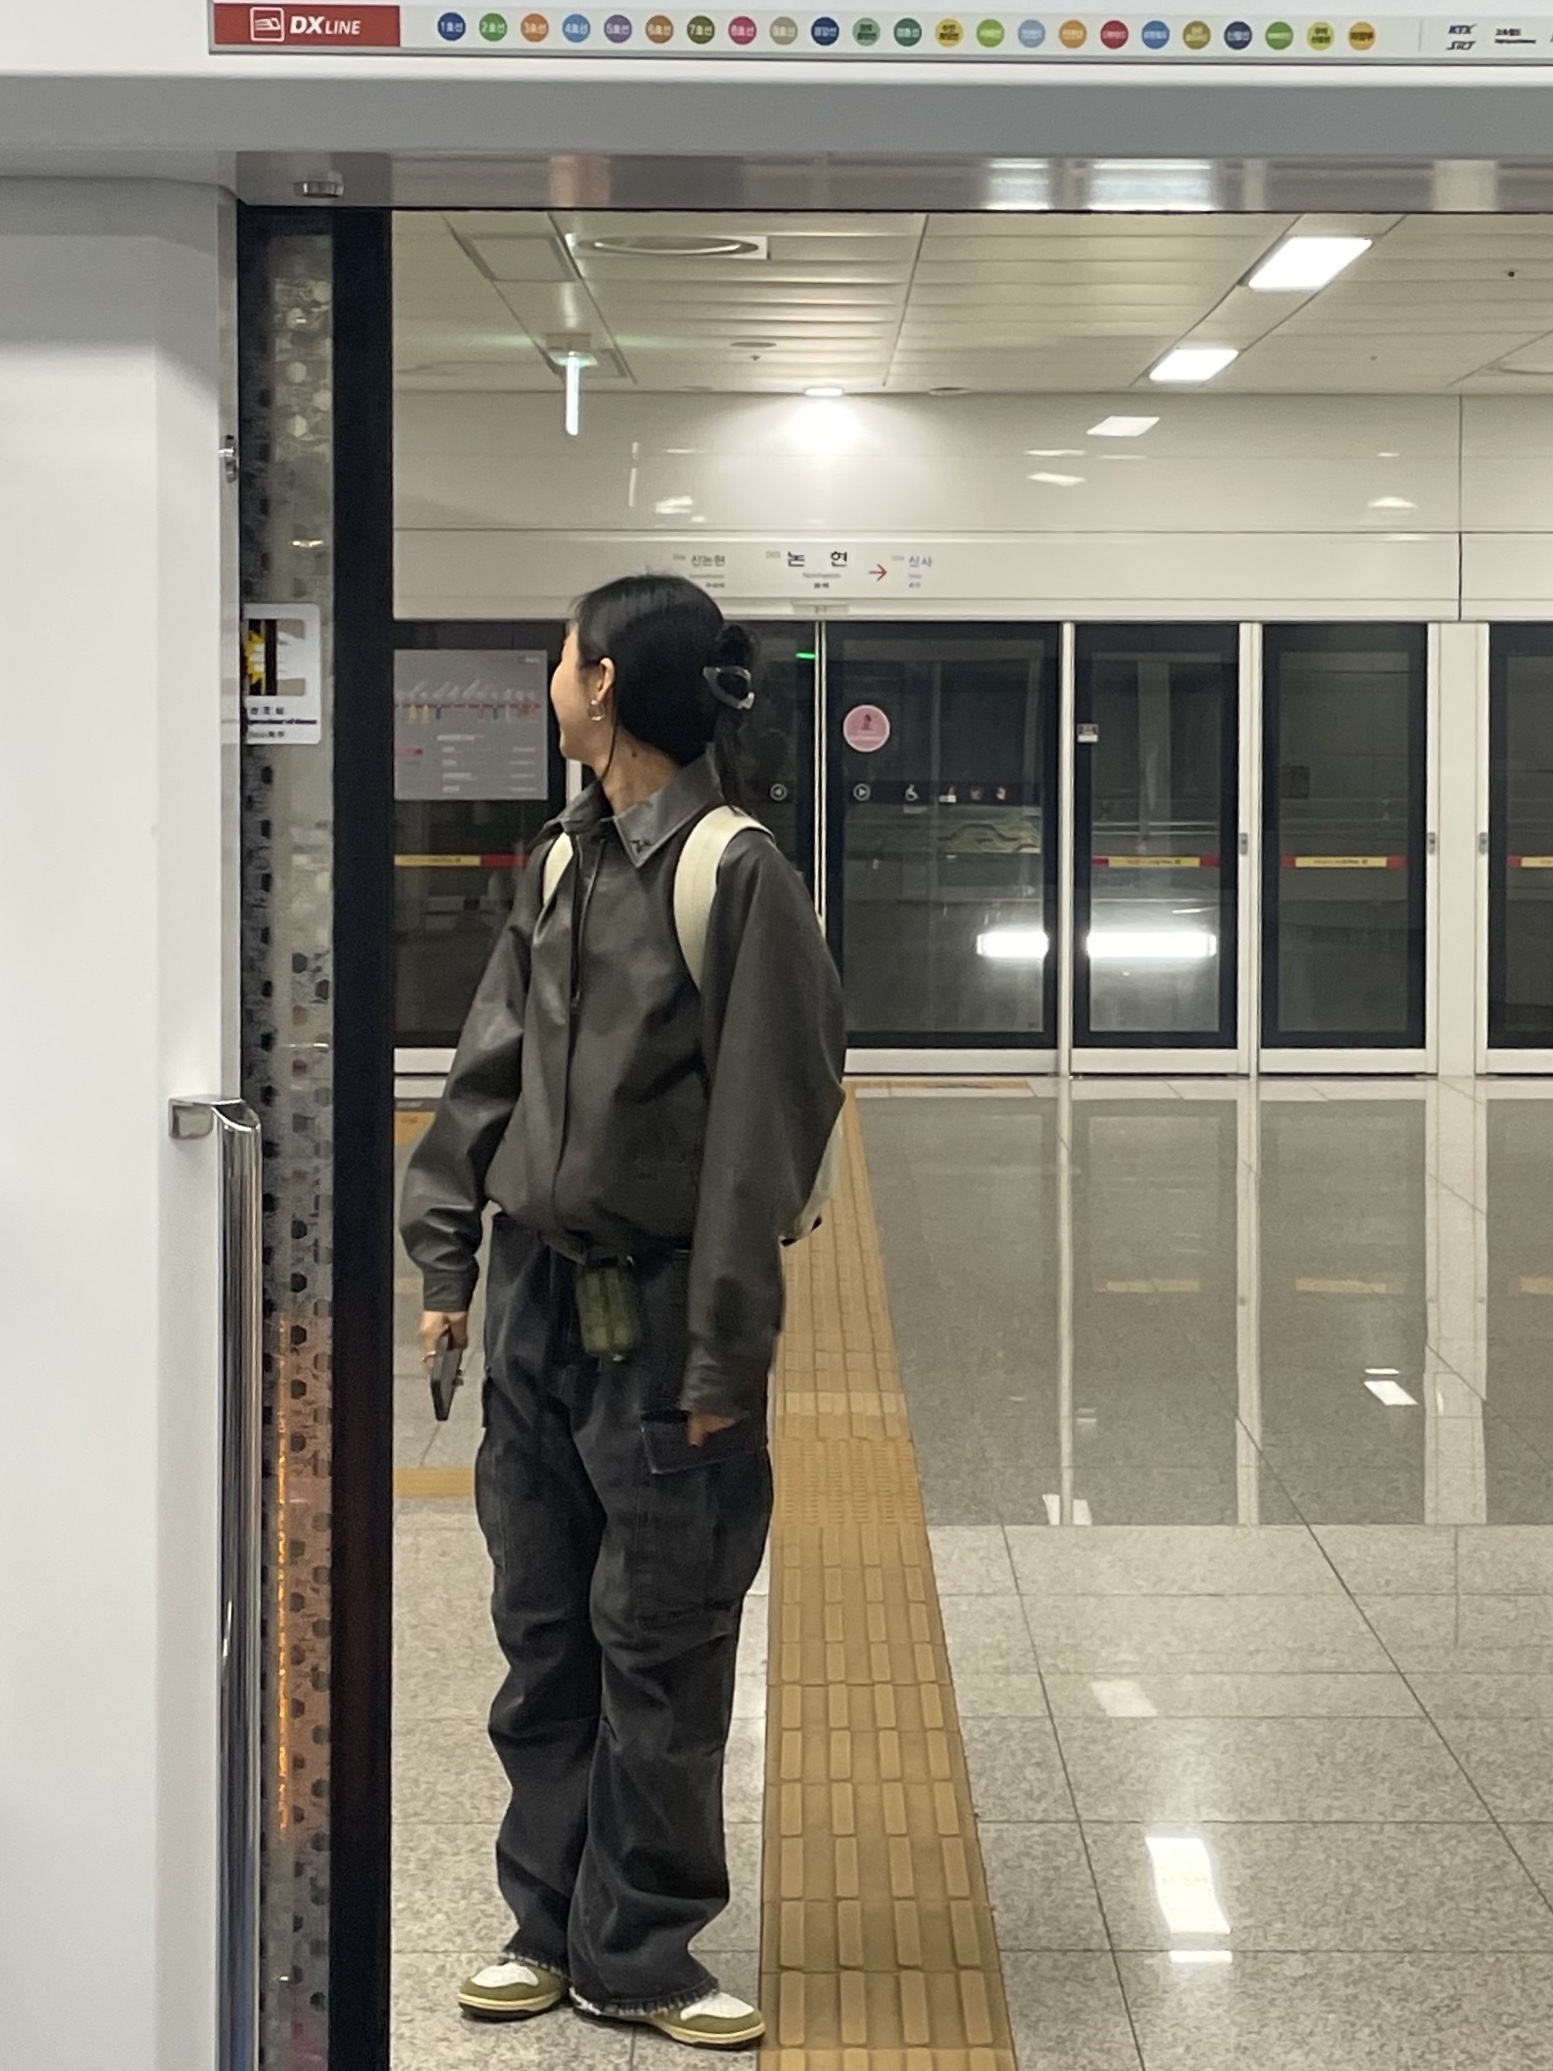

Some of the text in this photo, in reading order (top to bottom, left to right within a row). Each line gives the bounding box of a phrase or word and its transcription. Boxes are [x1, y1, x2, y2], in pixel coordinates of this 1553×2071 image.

[441, 22, 463, 33] 1호선
[482, 22, 505, 34] 2호선
[564, 23, 588, 34] 4호선
[606, 23, 630, 35] 5호선
[690, 24, 712, 36] 7호선
[691, 554, 725, 567] 신논현
[908, 555, 933, 568] 신사
